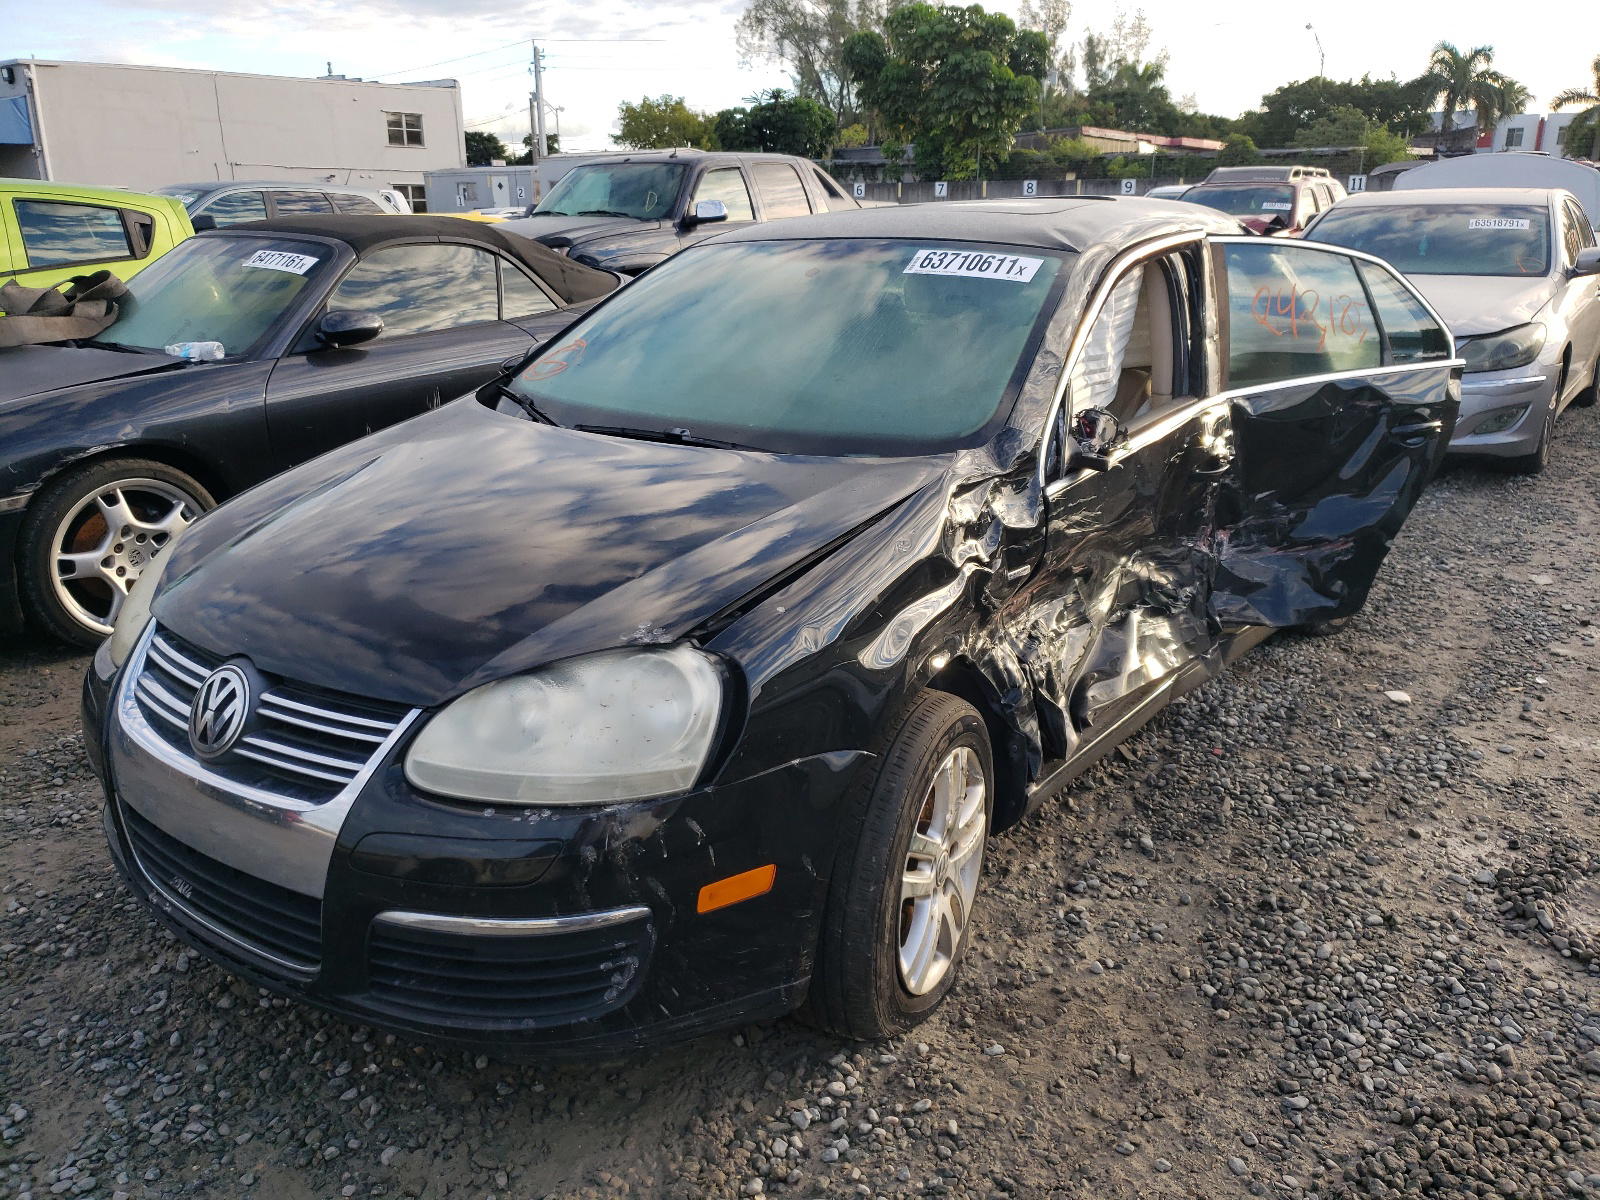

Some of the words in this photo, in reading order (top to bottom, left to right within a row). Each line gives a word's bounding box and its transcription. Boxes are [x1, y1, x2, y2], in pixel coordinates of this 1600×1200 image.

[856, 184, 863, 196] 6
[937, 183, 945, 195] 7
[1026, 182, 1034, 194] 8
[1124, 181, 1133, 193] 9
[1350, 178, 1364, 191] 11
